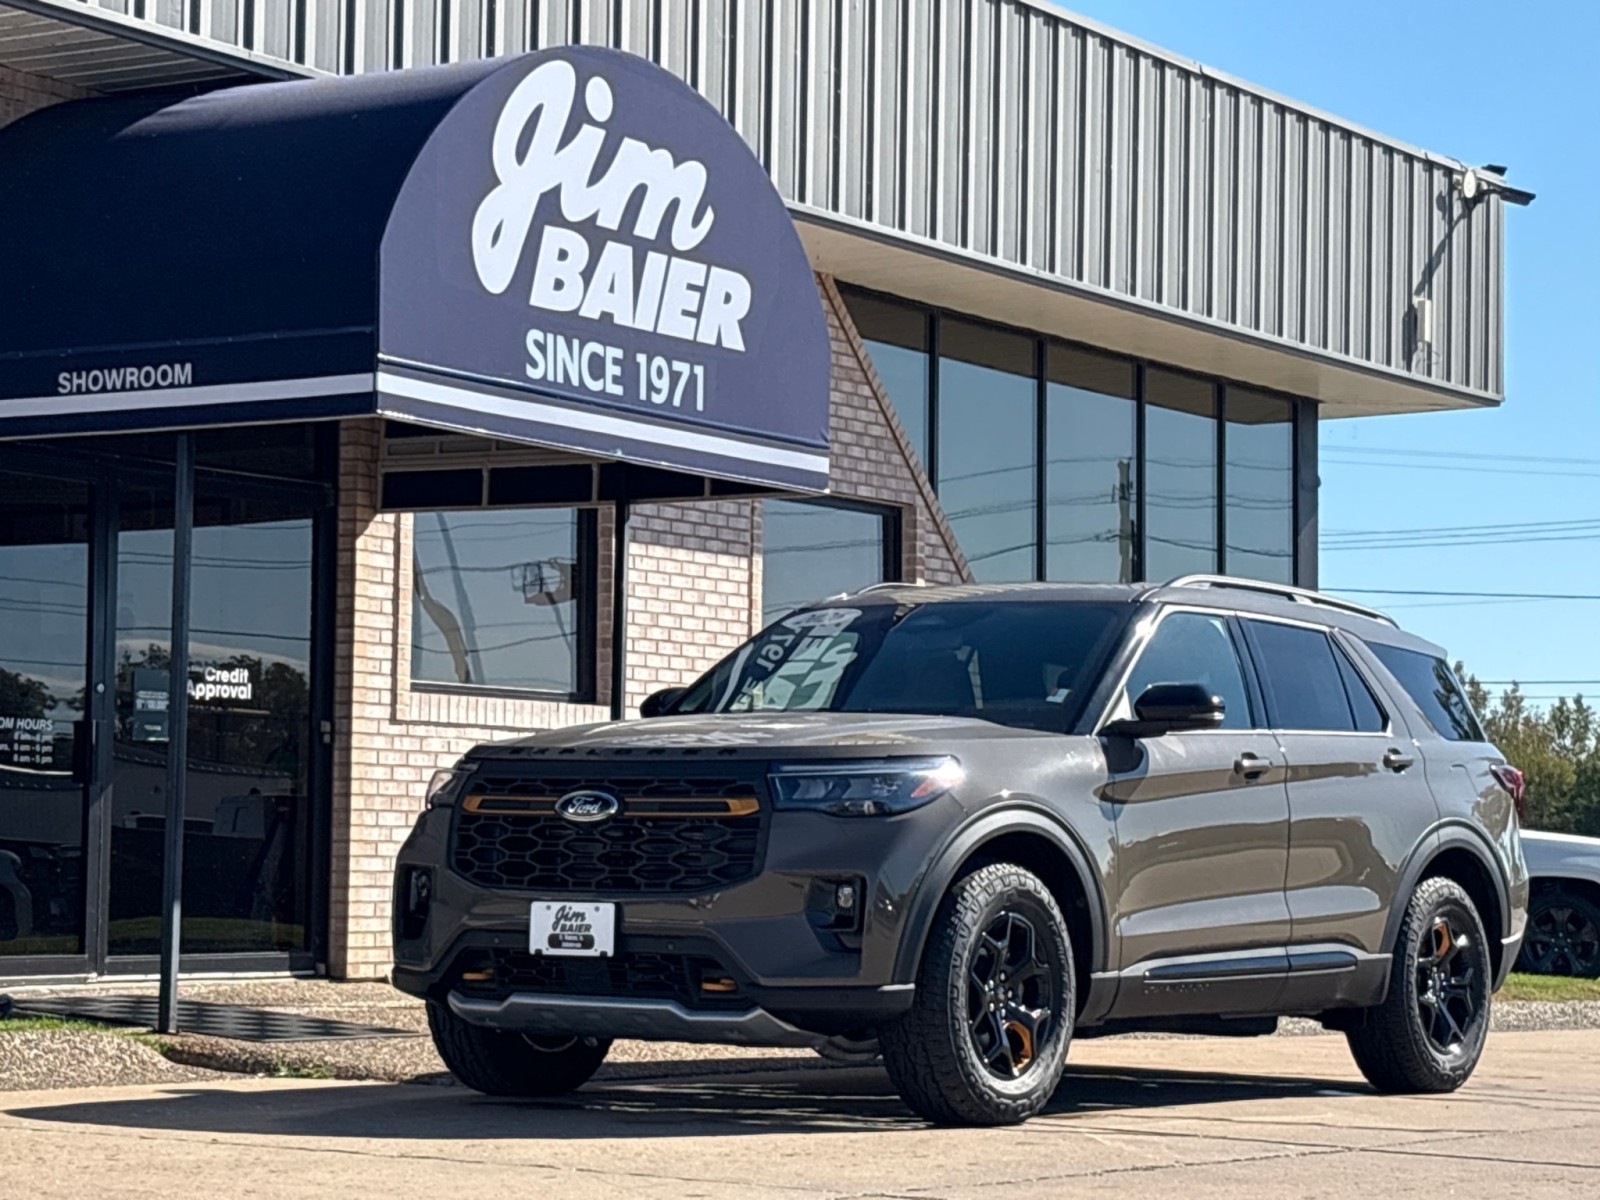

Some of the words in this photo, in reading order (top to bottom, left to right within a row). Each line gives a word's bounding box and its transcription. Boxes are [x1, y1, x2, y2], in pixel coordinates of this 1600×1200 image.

[472, 60, 715, 294] Jim
[529, 225, 752, 352] BAIER
[57, 362, 192, 394] SHOWROOM
[525, 329, 624, 396] SINCE
[636, 353, 705, 412] 1971
[205, 666, 249, 683] Credit
[187, 679, 252, 701] Approval
[16, 717, 53, 731] HOURS
[568, 796, 602, 814] Ford
[552, 905, 586, 931] Jim
[560, 923, 592, 933] BAIER
